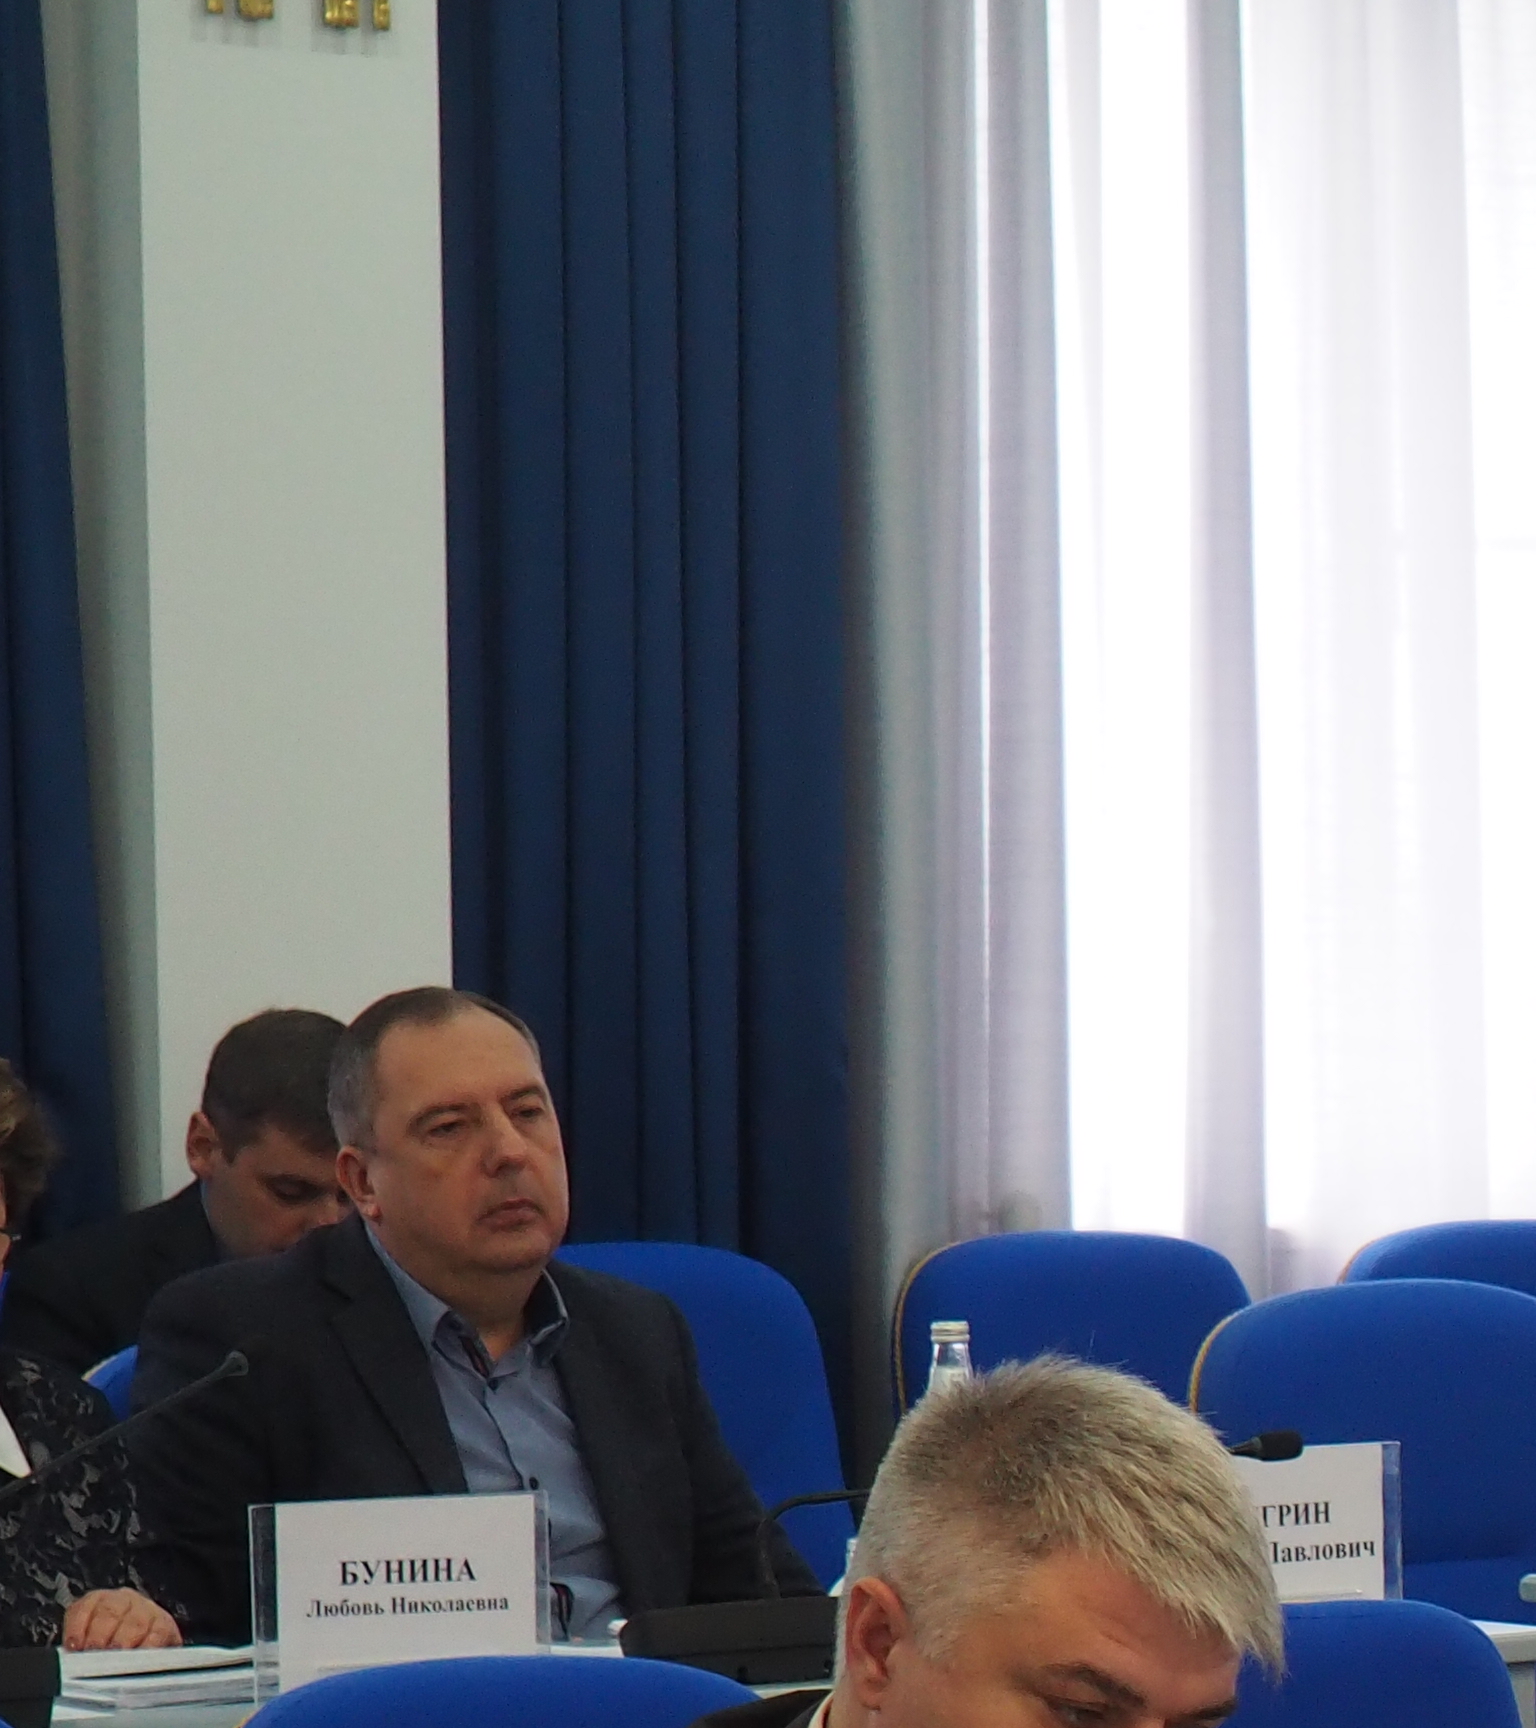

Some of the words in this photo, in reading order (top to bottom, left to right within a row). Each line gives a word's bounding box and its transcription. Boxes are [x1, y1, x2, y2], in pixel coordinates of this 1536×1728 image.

[1256, 1501, 1331, 1527] ГРИН
[339, 1557, 476, 1586] БУНИНА
[306, 1598, 385, 1618] Любовь
[391, 1596, 509, 1615] Николаевна
